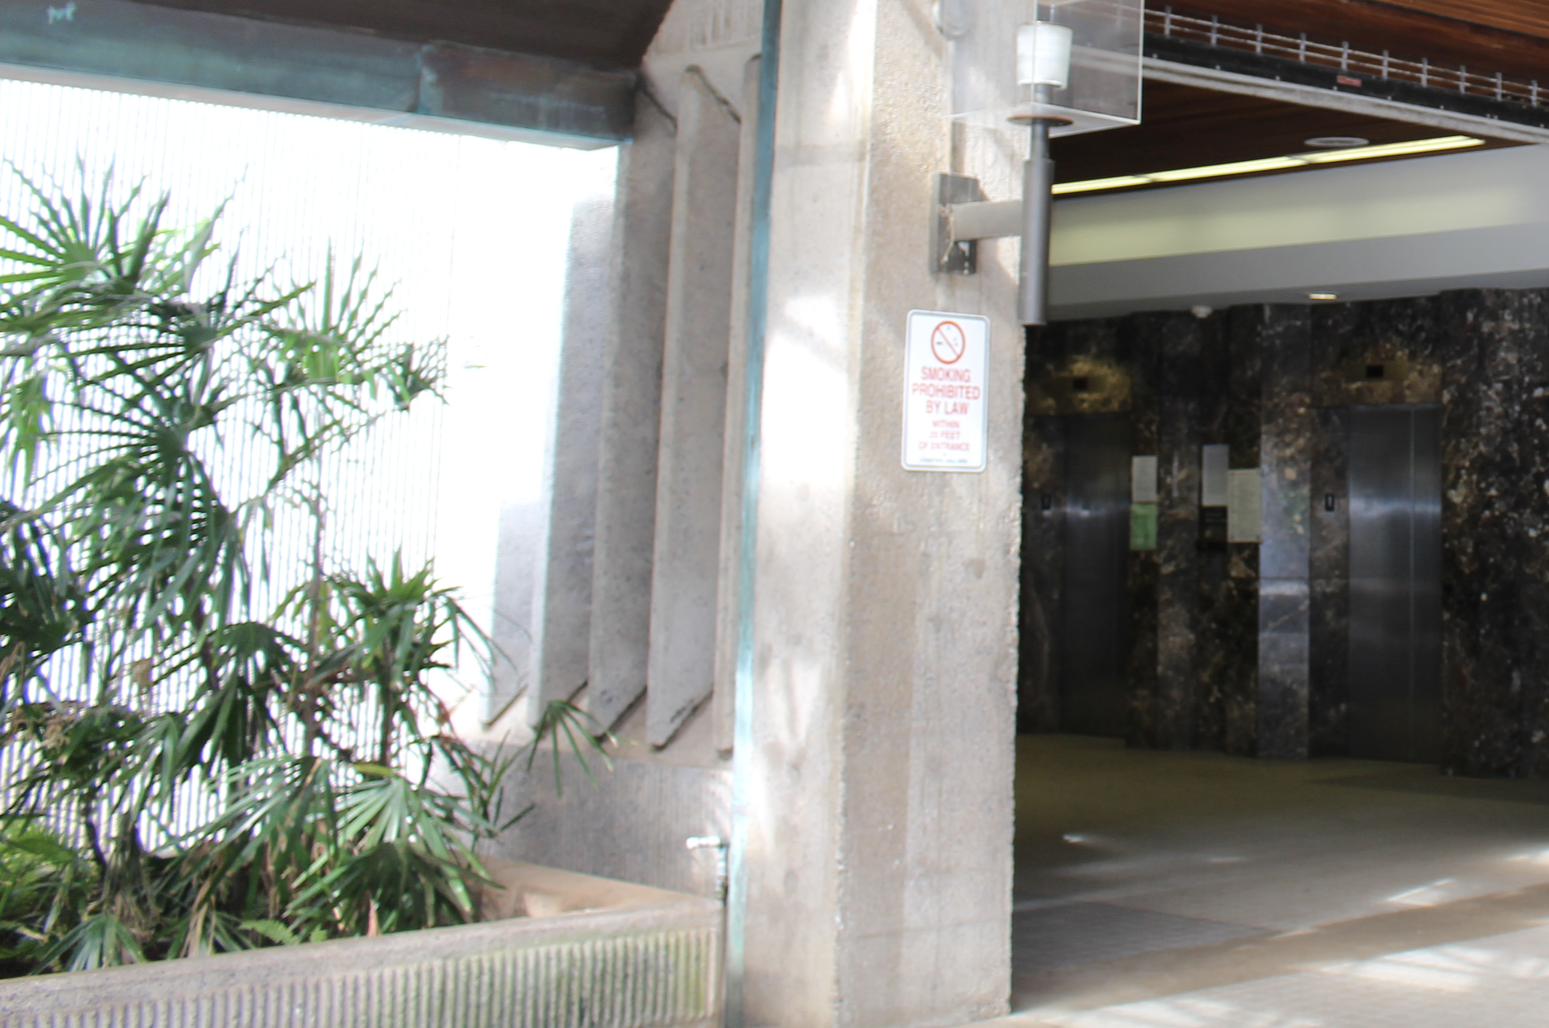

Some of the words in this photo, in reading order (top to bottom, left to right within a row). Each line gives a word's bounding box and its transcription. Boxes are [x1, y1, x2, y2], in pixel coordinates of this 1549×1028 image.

[921, 366, 971, 383] SMOKING
[912, 382, 980, 400] PROHIBITED
[925, 400, 942, 414] BY
[944, 401, 970, 415] LAW
[941, 430, 961, 440] FEET
[918, 440, 928, 450] OF
[931, 441, 971, 452] ENTRANCE
